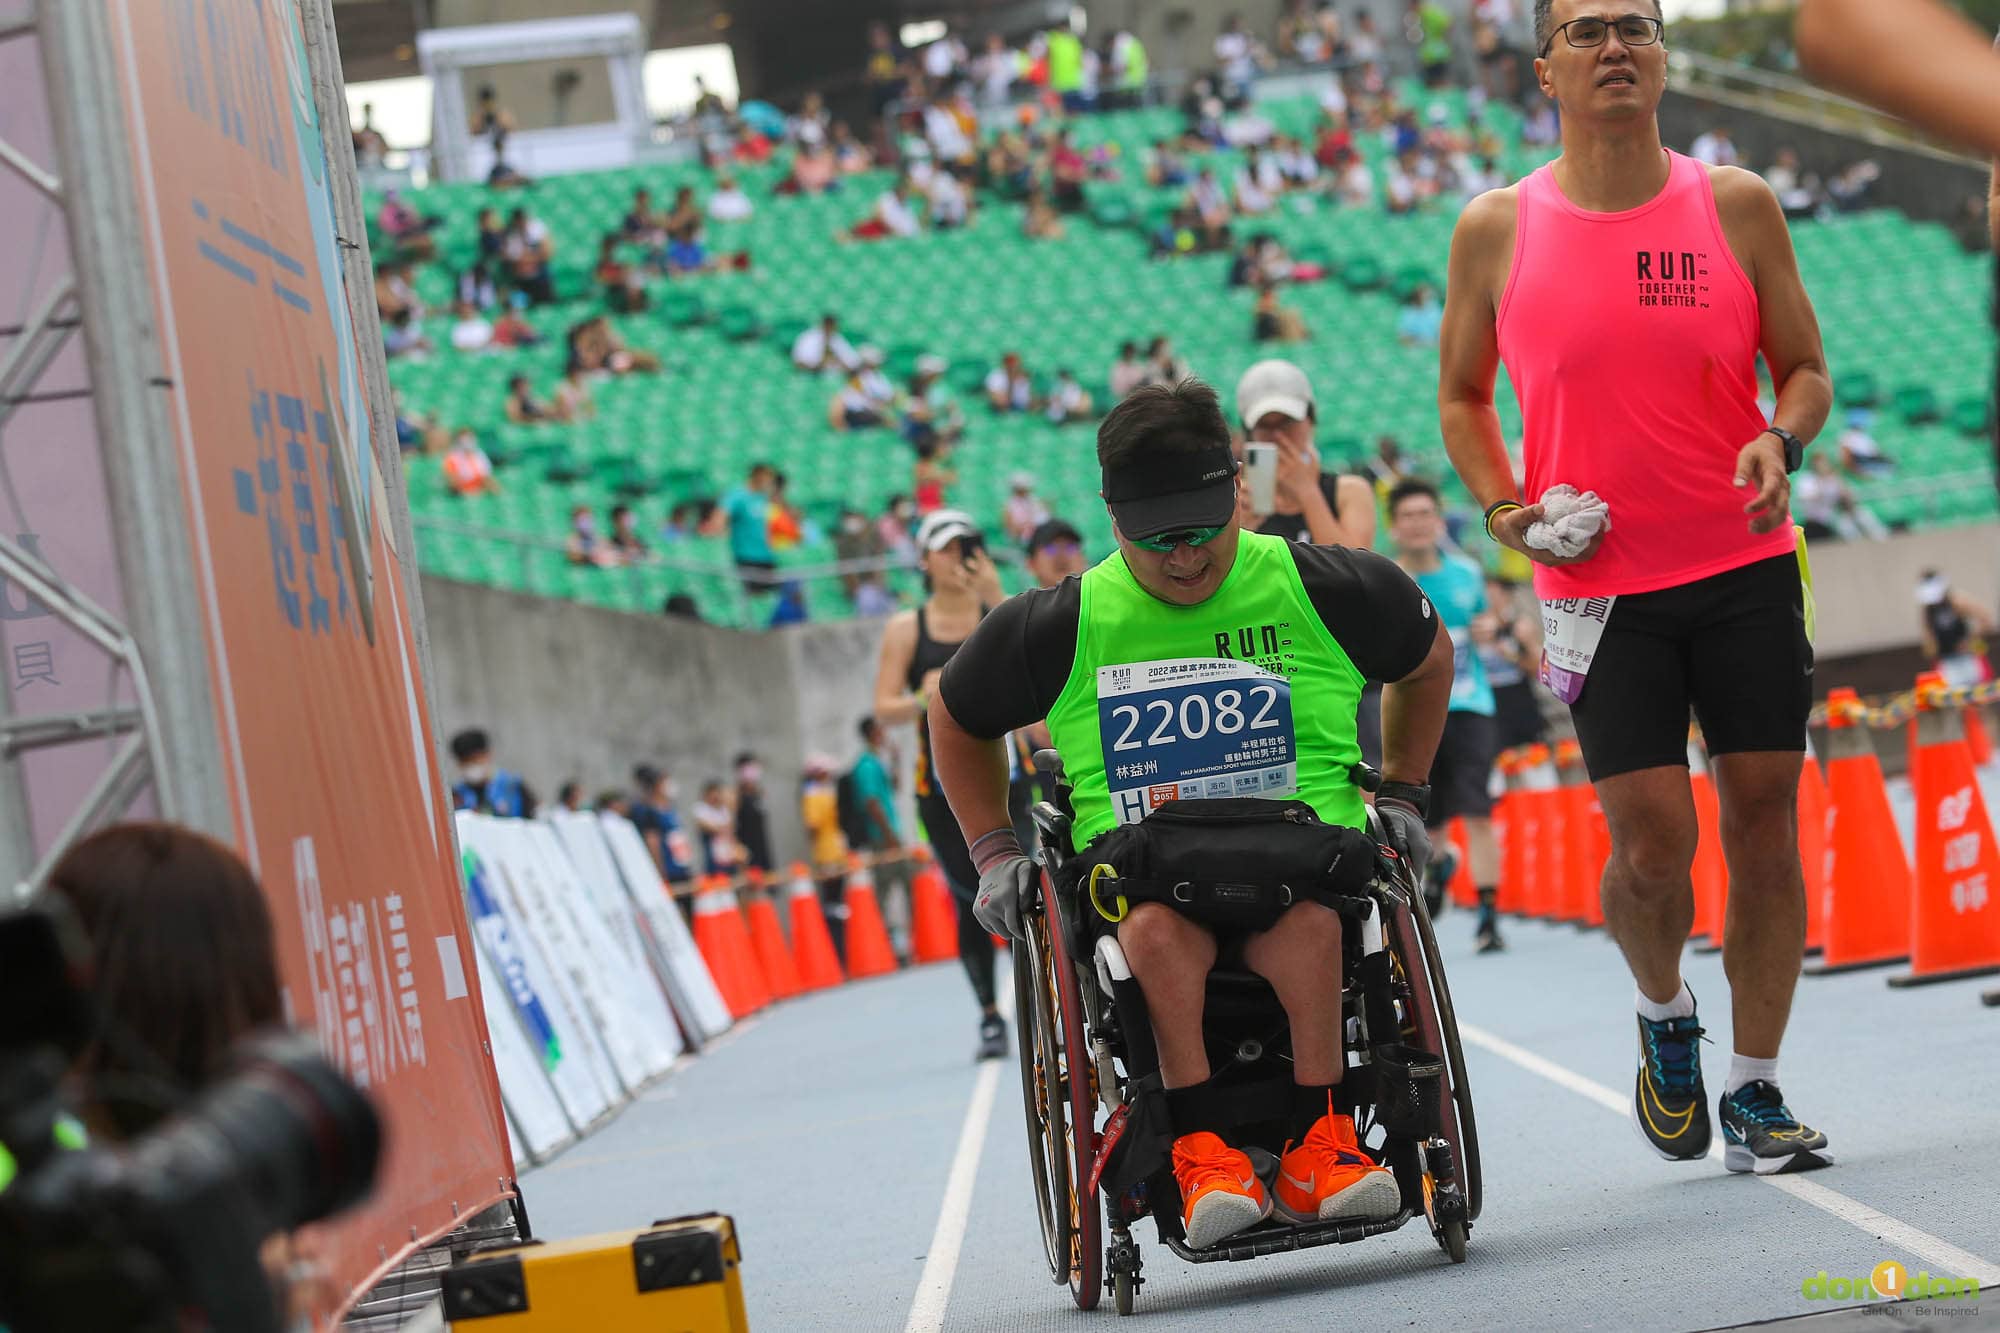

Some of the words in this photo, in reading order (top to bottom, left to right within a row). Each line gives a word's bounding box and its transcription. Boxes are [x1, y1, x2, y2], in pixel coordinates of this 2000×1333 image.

[1638, 283, 1696, 295] TOGETHER
[1639, 295, 1658, 306] FOR
[1661, 295, 1696, 307] BETTER
[1112, 685, 1280, 752] 22082
[1241, 735, 1287, 750] 半程馬拉松
[1224, 745, 1287, 763] 運動輪椅男子組
[1115, 759, 1158, 780] 林益州
[1193, 765, 1223, 775] MARATHON
[1121, 790, 1146, 822] H
